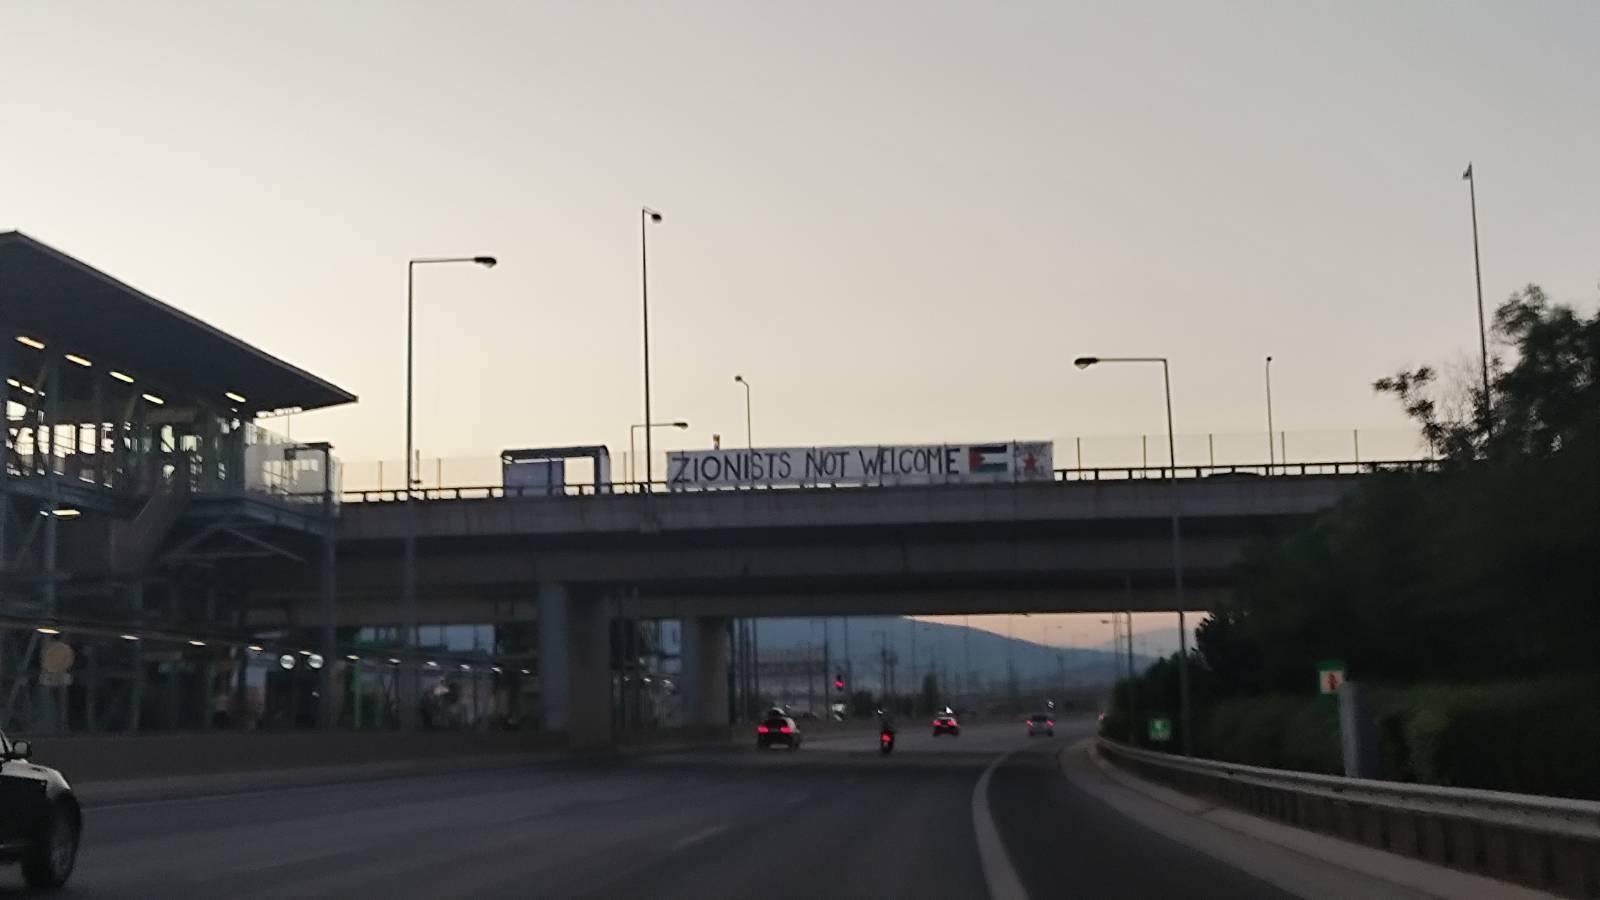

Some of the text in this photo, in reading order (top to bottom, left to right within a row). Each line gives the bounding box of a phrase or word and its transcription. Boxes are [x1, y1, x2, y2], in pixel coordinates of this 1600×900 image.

[672, 446, 960, 482] ZIONISTS NOT WELCOME
